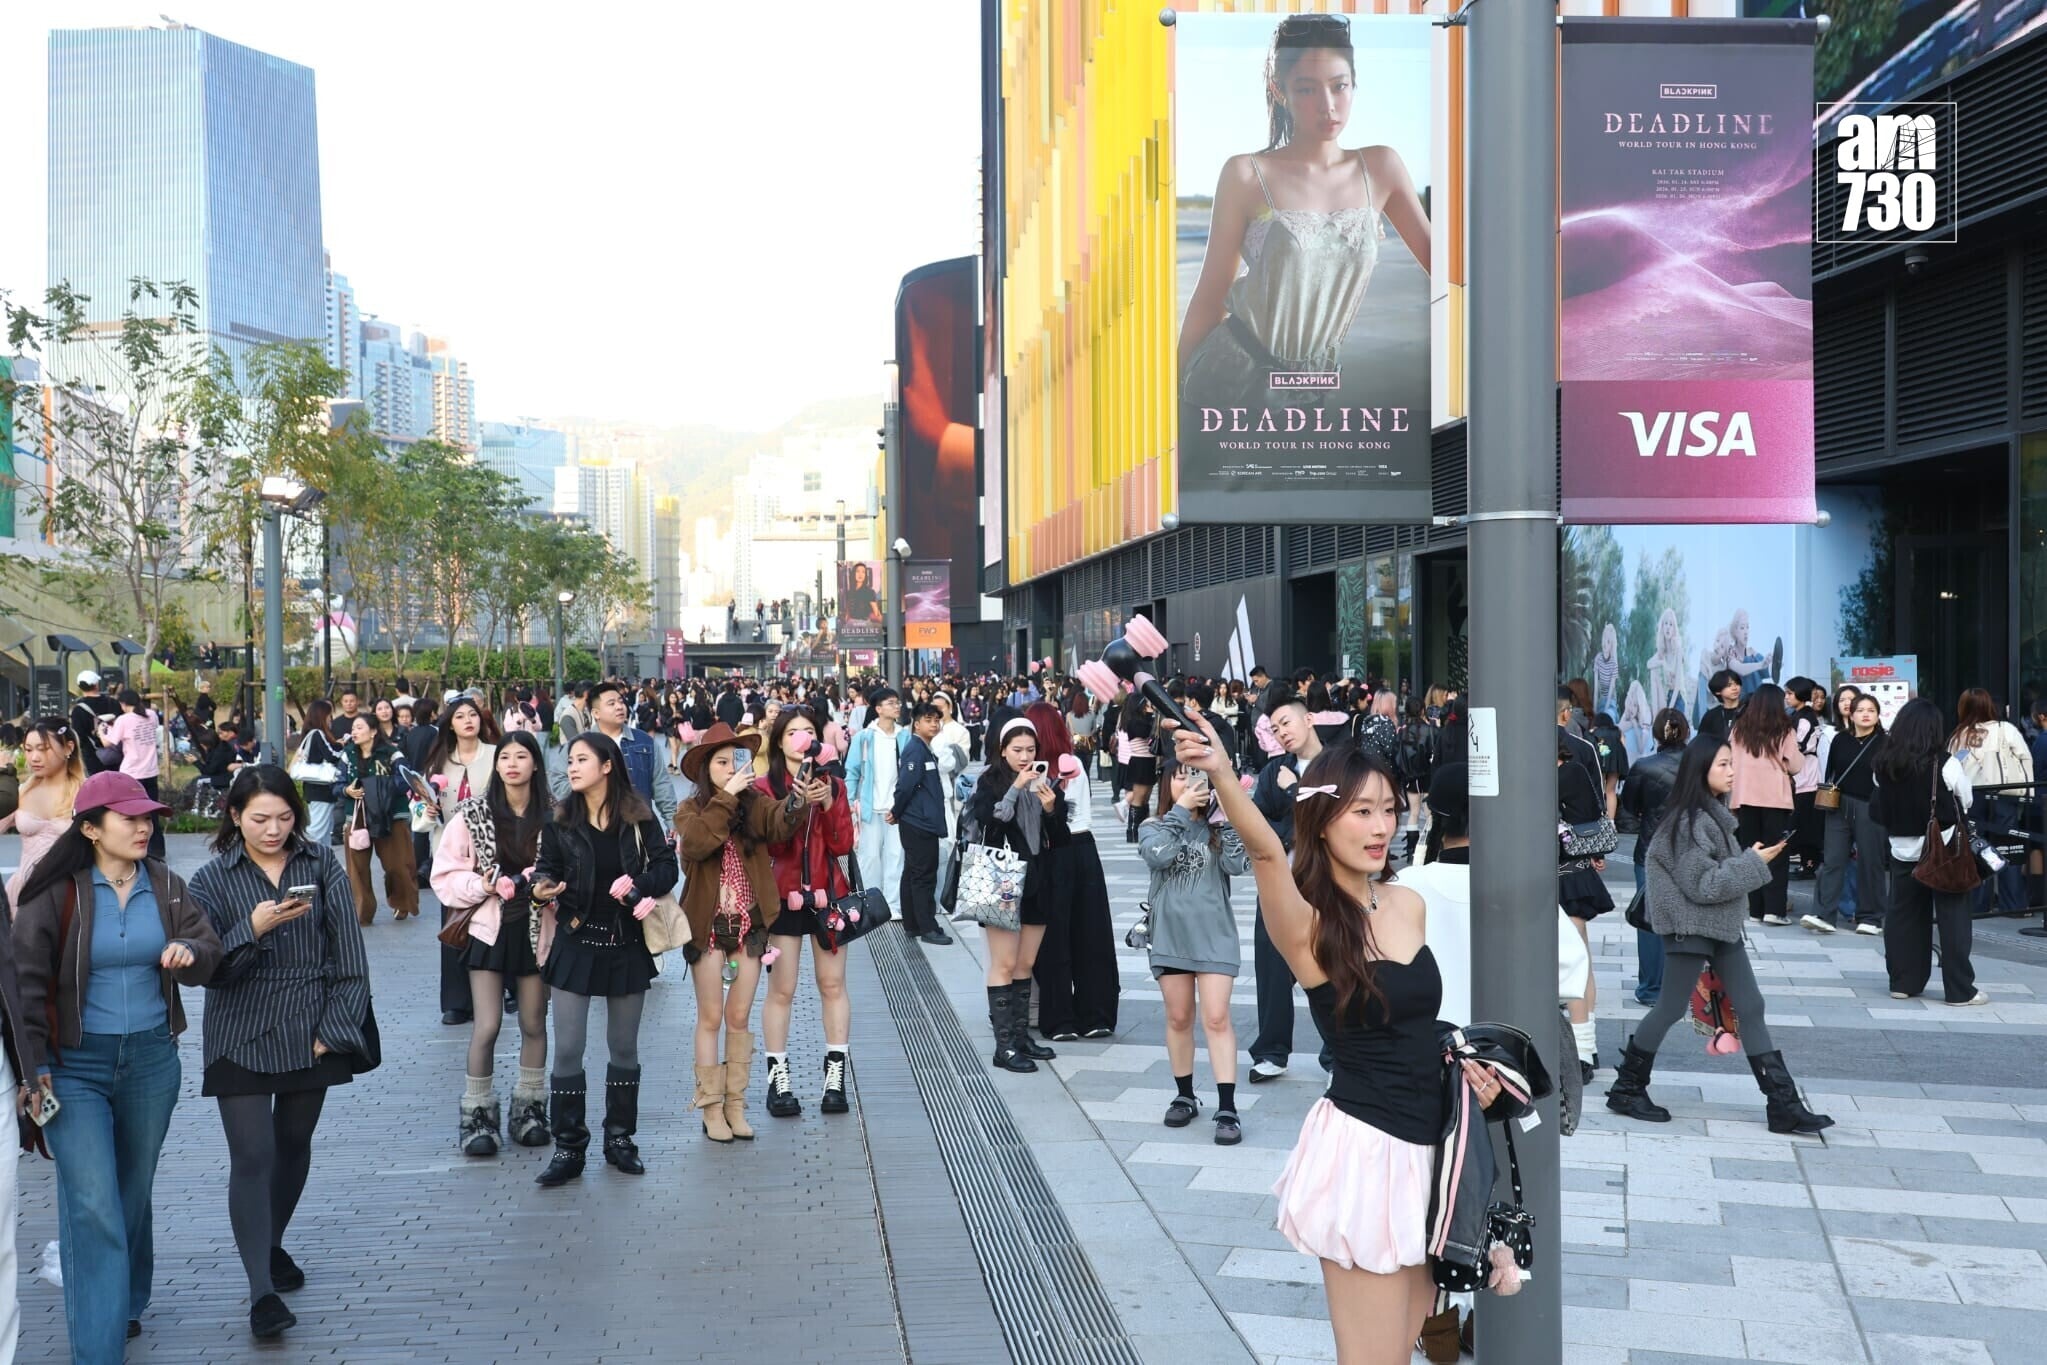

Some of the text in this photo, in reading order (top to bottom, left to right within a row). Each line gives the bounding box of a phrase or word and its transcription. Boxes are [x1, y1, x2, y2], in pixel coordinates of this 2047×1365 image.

[1664, 88, 1713, 96] BLACKPINK
[1604, 112, 1774, 134] DEADLINE
[1618, 140, 1652, 148] WORLD
[1274, 376, 1335, 385] BLACKPINK
[1200, 408, 1409, 432] DEADLINE
[1617, 411, 1757, 456] VISA
[1220, 441, 1392, 449] WORLD TOUR IN HONG KONG
